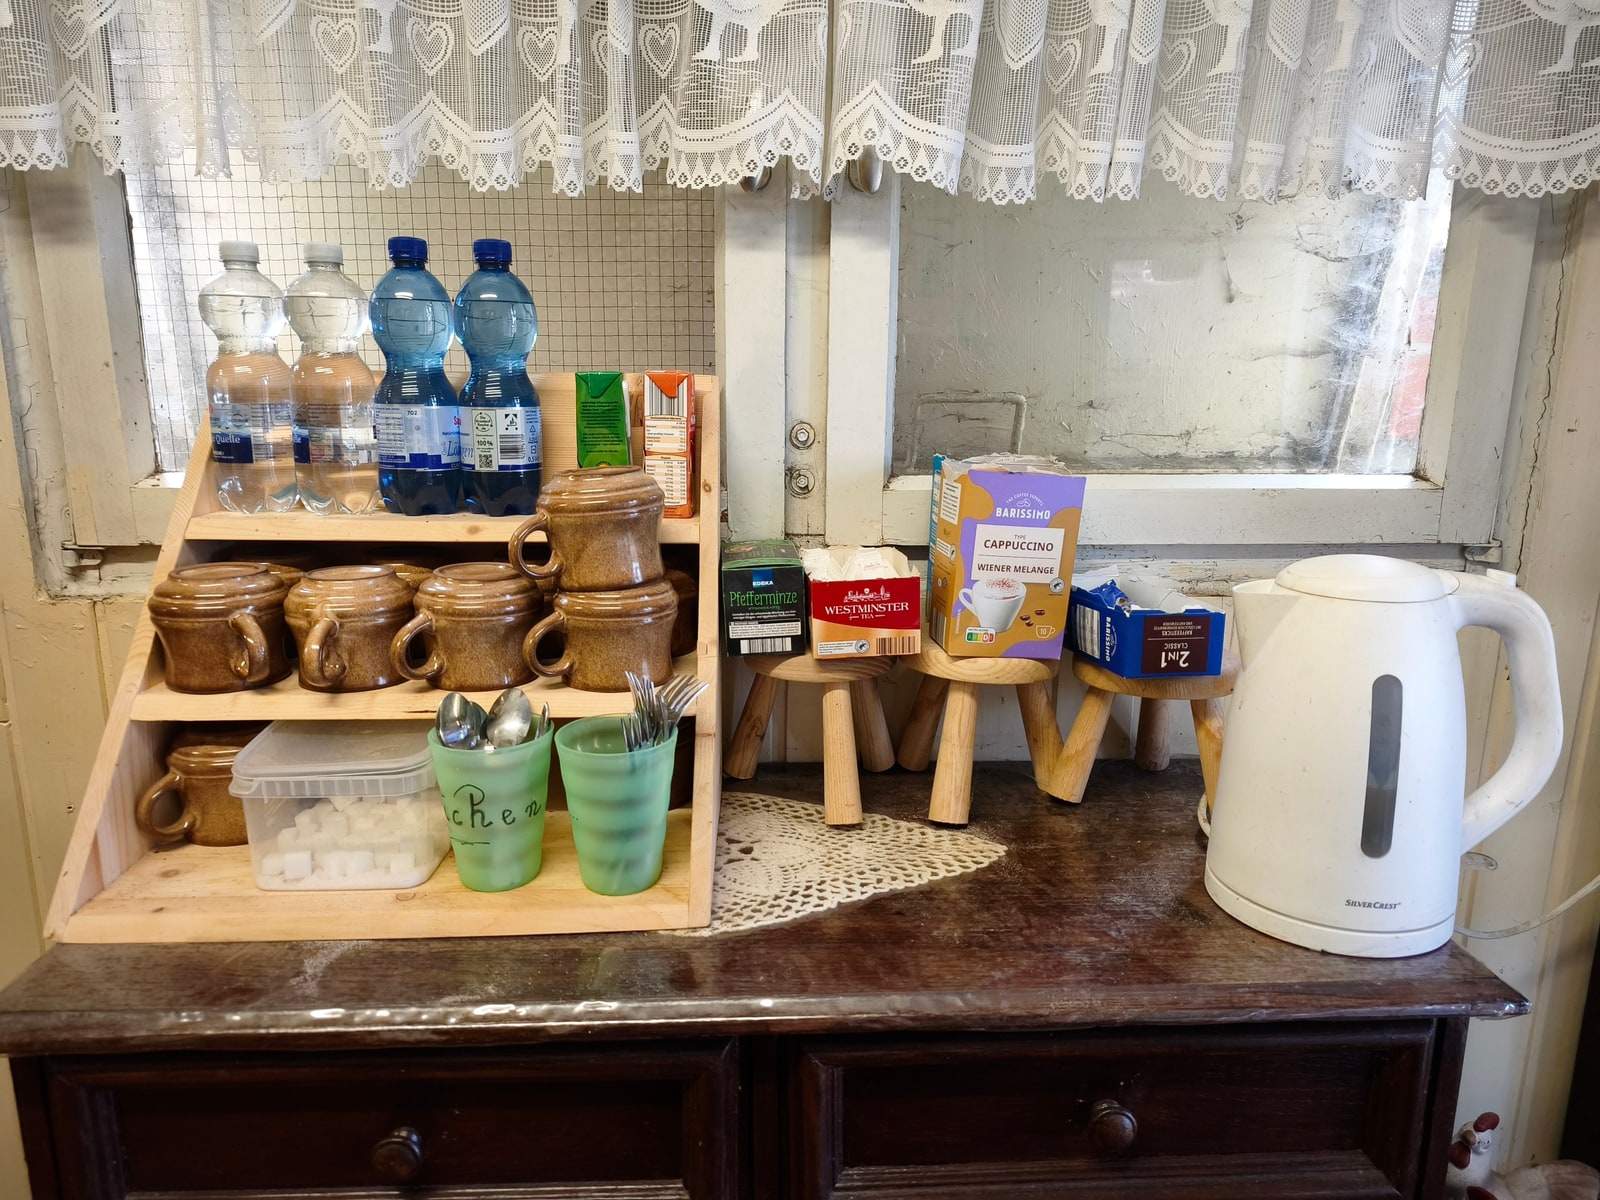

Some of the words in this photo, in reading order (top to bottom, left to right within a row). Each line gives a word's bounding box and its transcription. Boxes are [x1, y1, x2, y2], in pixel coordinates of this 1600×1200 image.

[215, 434, 241, 445] Quelle
[996, 507, 1051, 520] BARISSIMO
[983, 539, 1054, 552] CAPPUCCINO
[977, 563, 1011, 573] WIENER
[1013, 565, 1055, 575] MELANGE
[729, 591, 798, 607] Pfefferminze
[824, 602, 910, 615] WESTMINSTER
[1104, 616, 1112, 662] BARISSIMO
